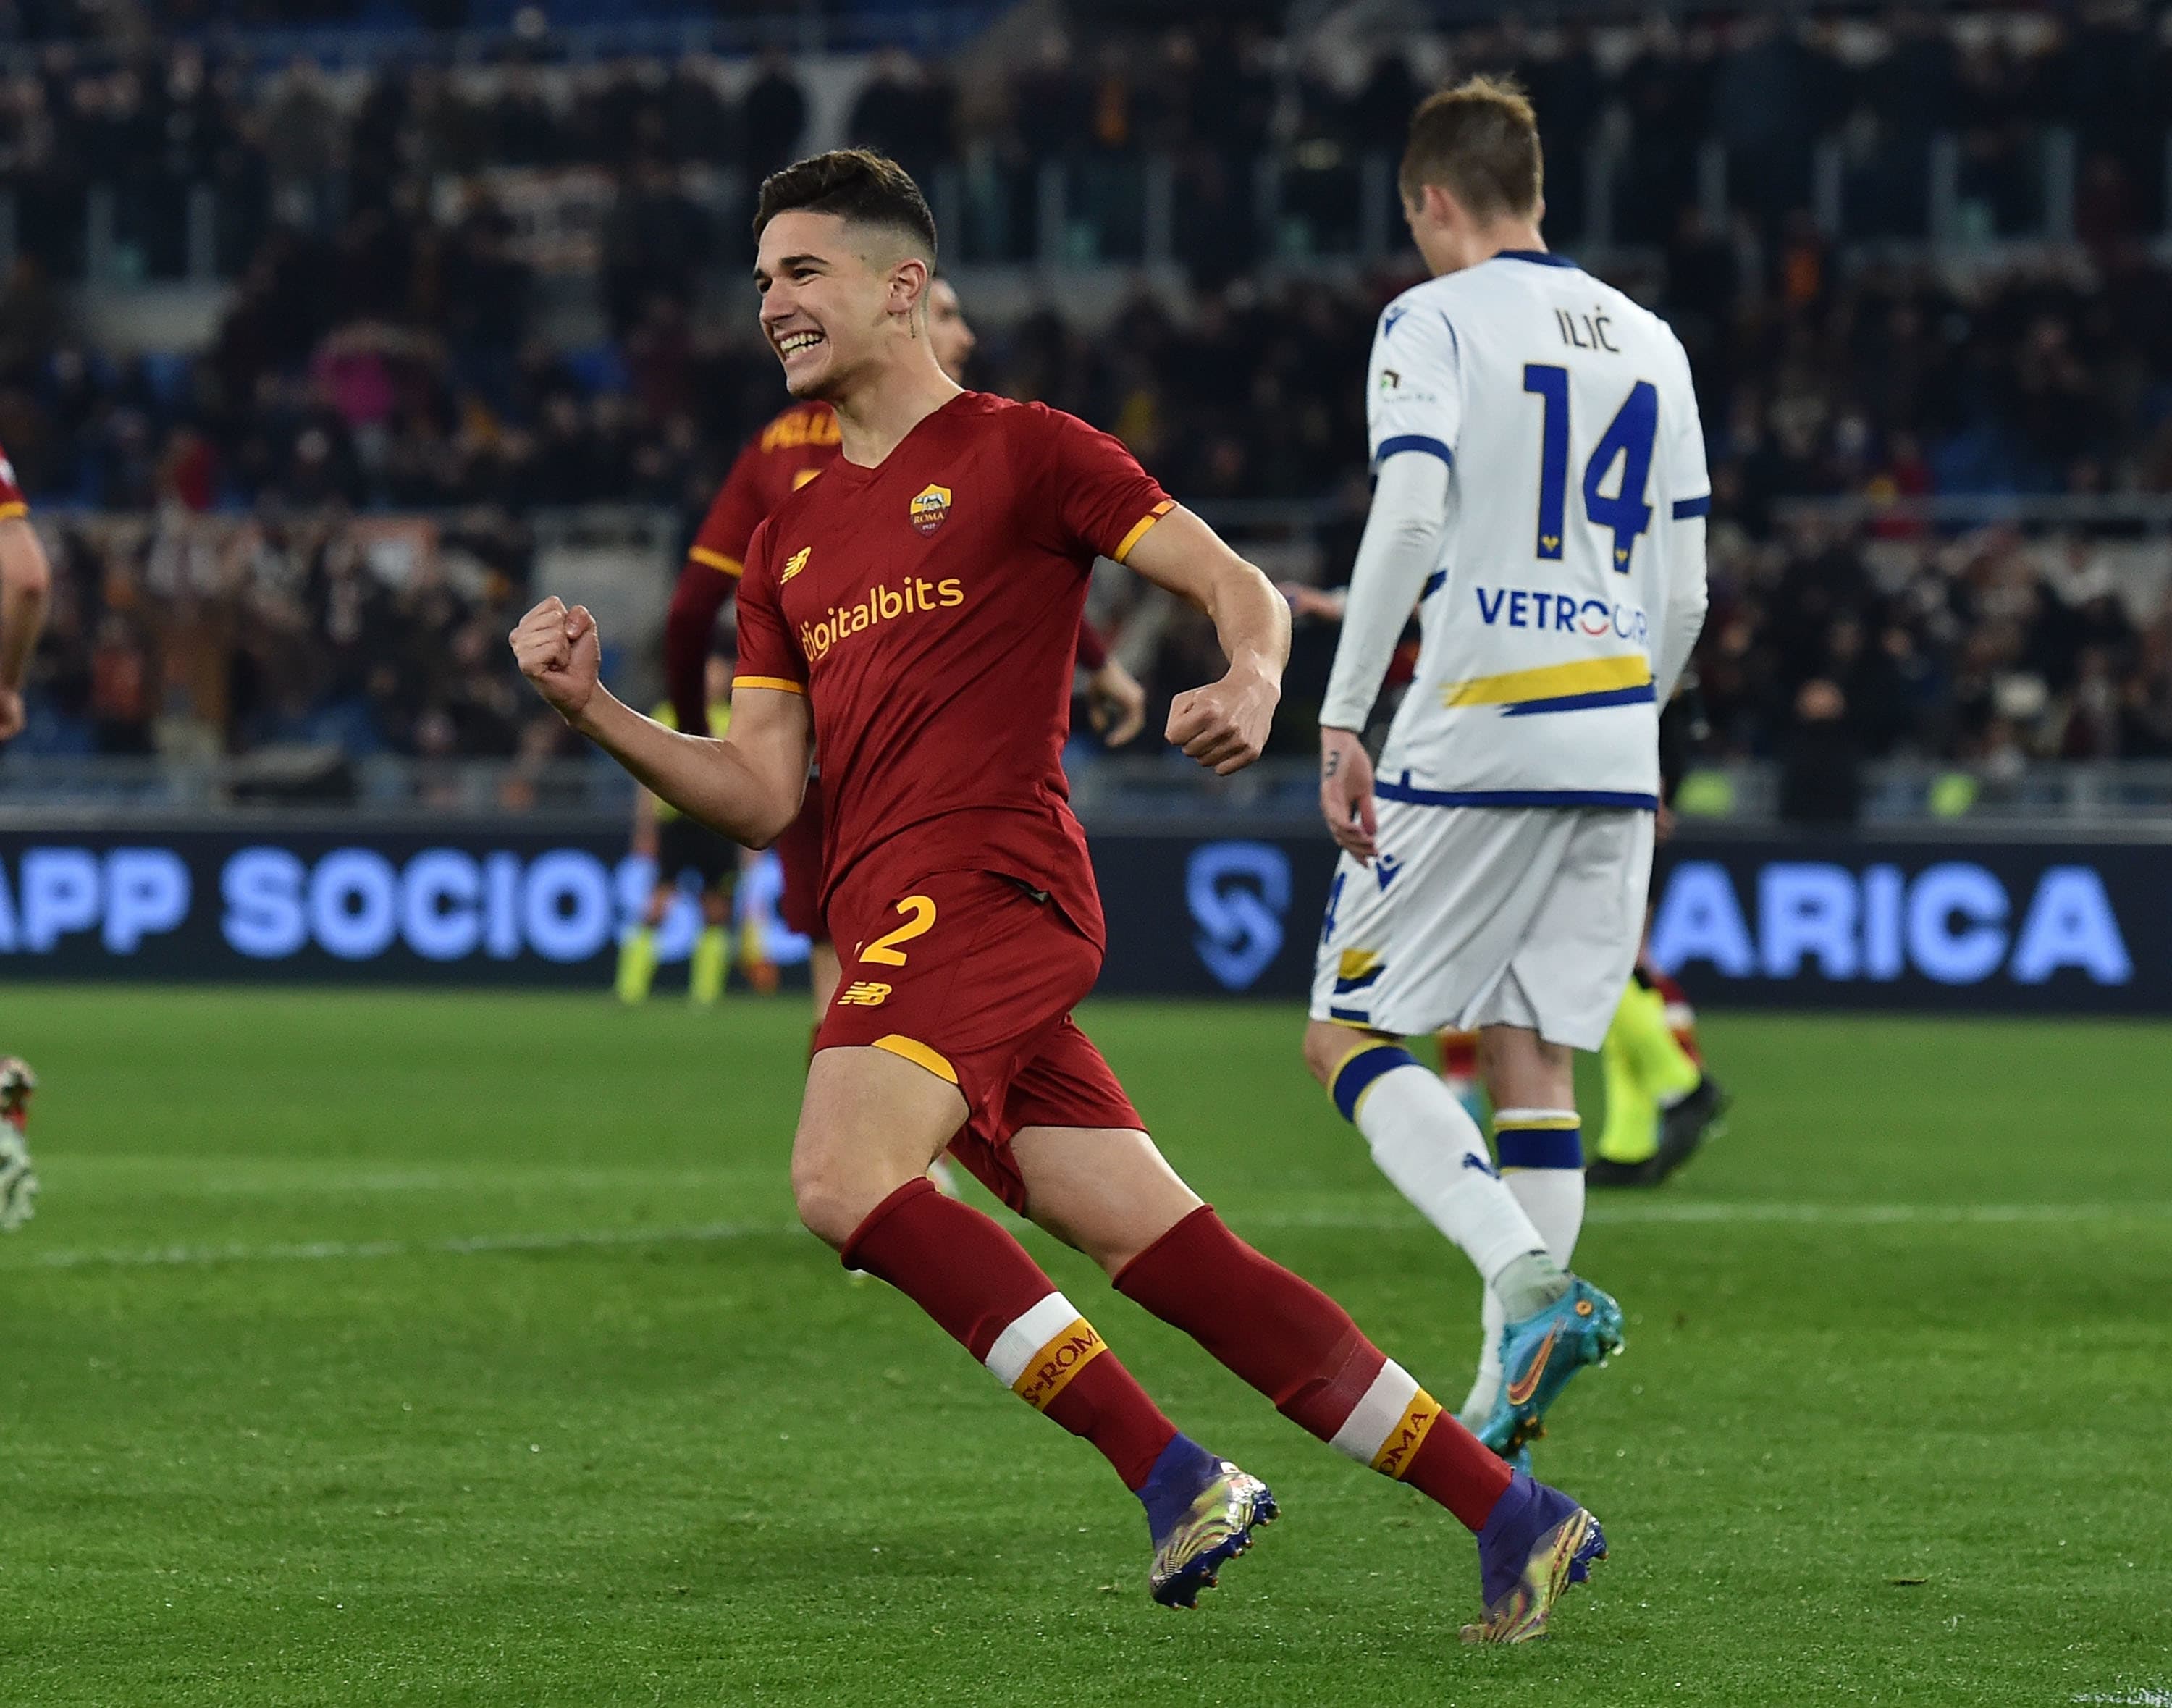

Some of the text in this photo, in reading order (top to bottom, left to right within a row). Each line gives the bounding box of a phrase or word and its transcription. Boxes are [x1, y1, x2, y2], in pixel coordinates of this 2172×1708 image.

[1523, 363, 1658, 573] 14
[914, 511, 944, 524] ROMA
[800, 576, 964, 662] digitalbits
[0, 846, 191, 954] PP
[854, 895, 937, 966] 2
